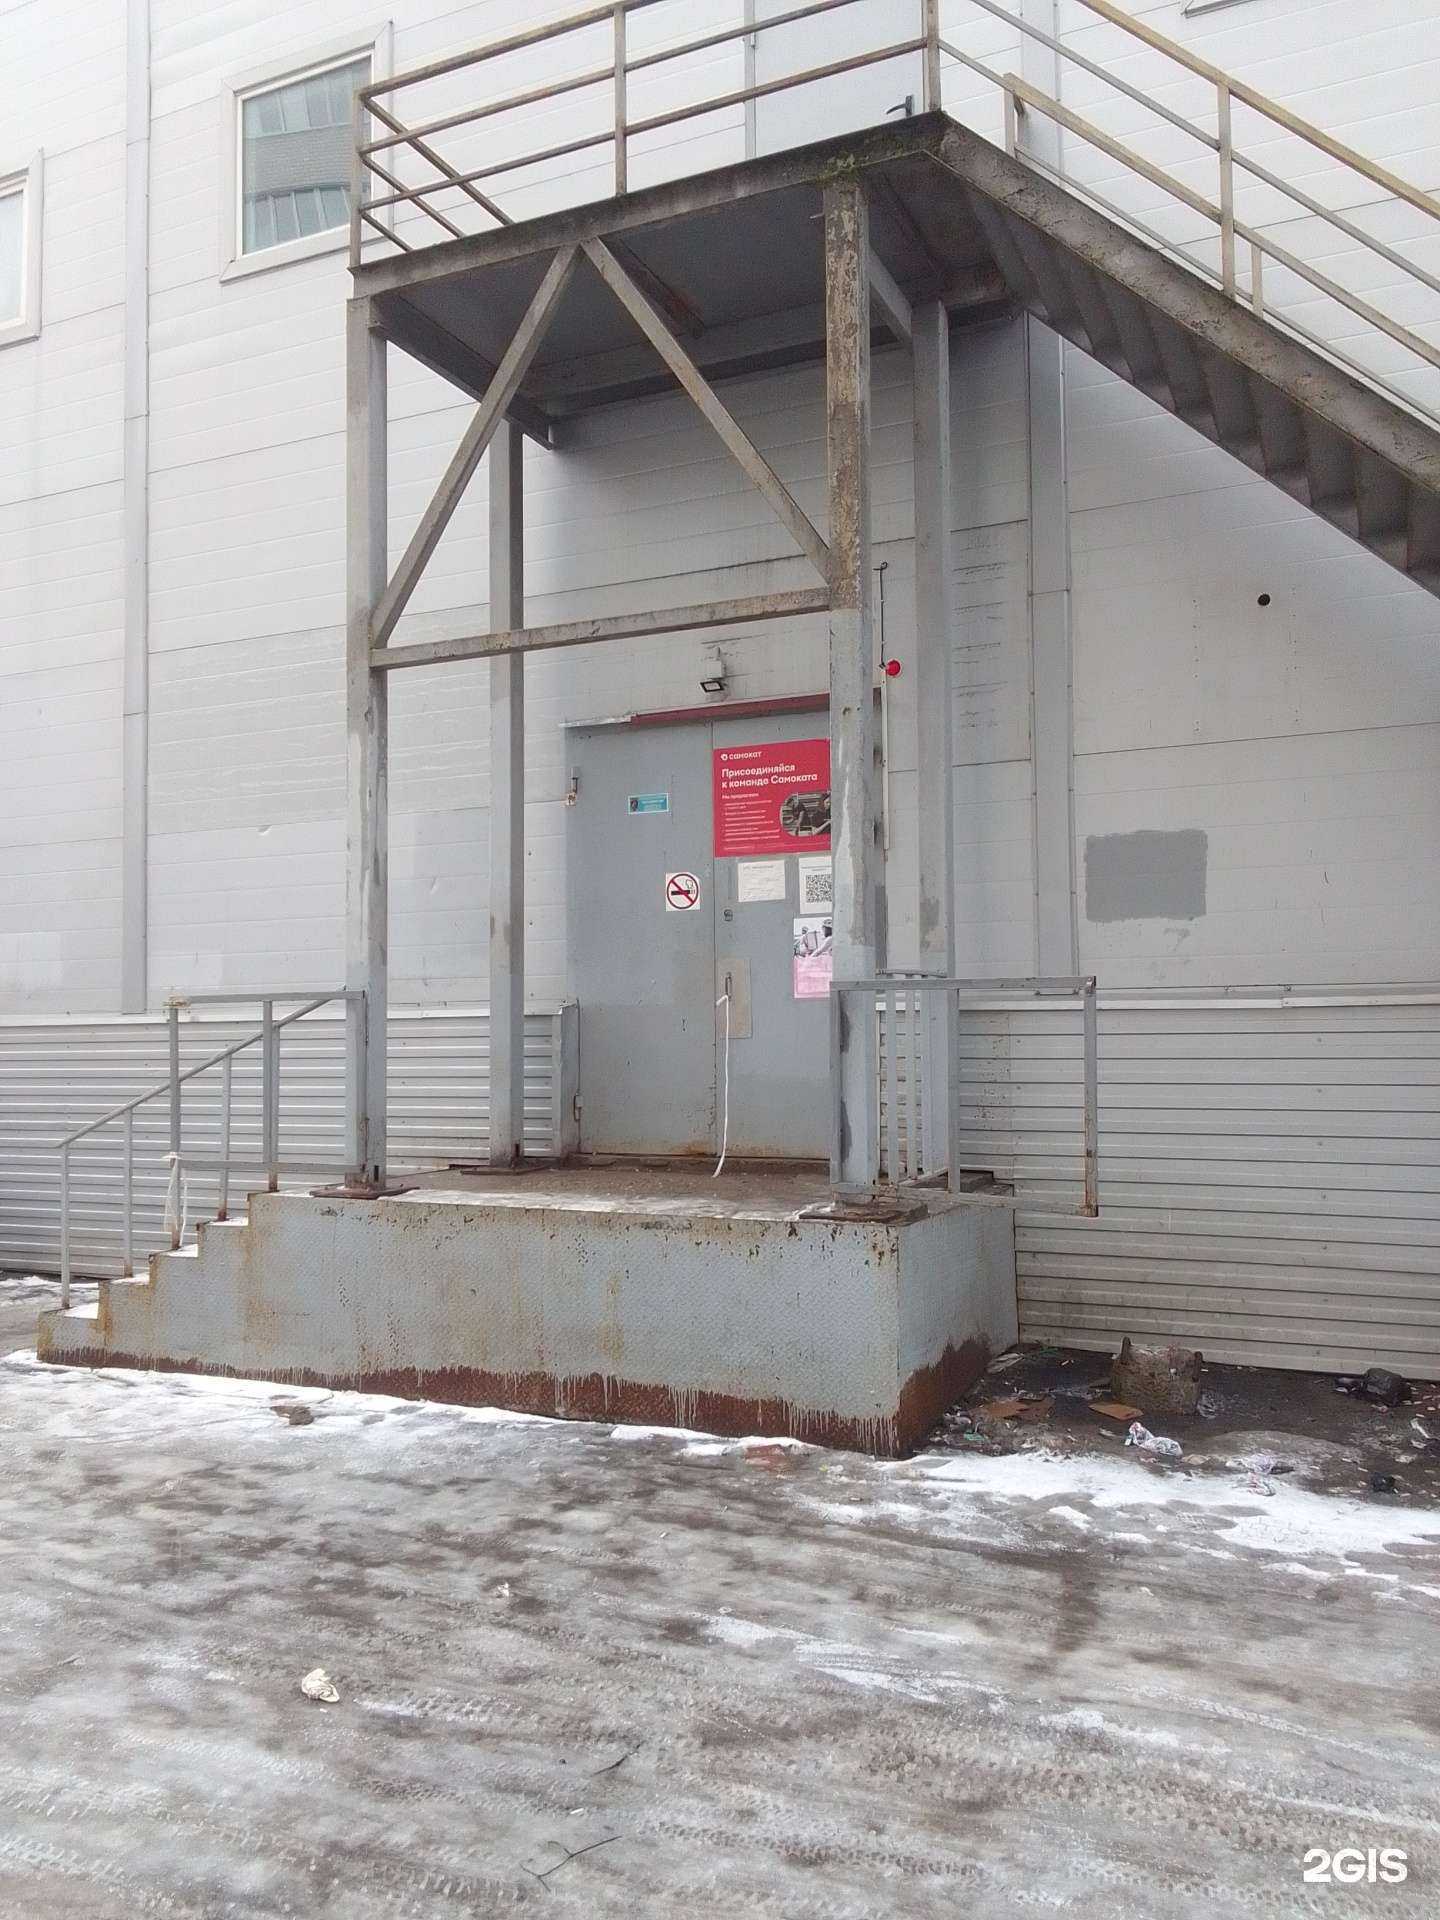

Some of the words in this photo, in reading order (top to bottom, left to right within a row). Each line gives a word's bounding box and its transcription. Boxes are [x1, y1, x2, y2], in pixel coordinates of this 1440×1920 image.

[729, 751, 762, 760] самокат
[721, 764, 795, 778] Присоединяйся
[771, 773, 818, 784] Самоката
